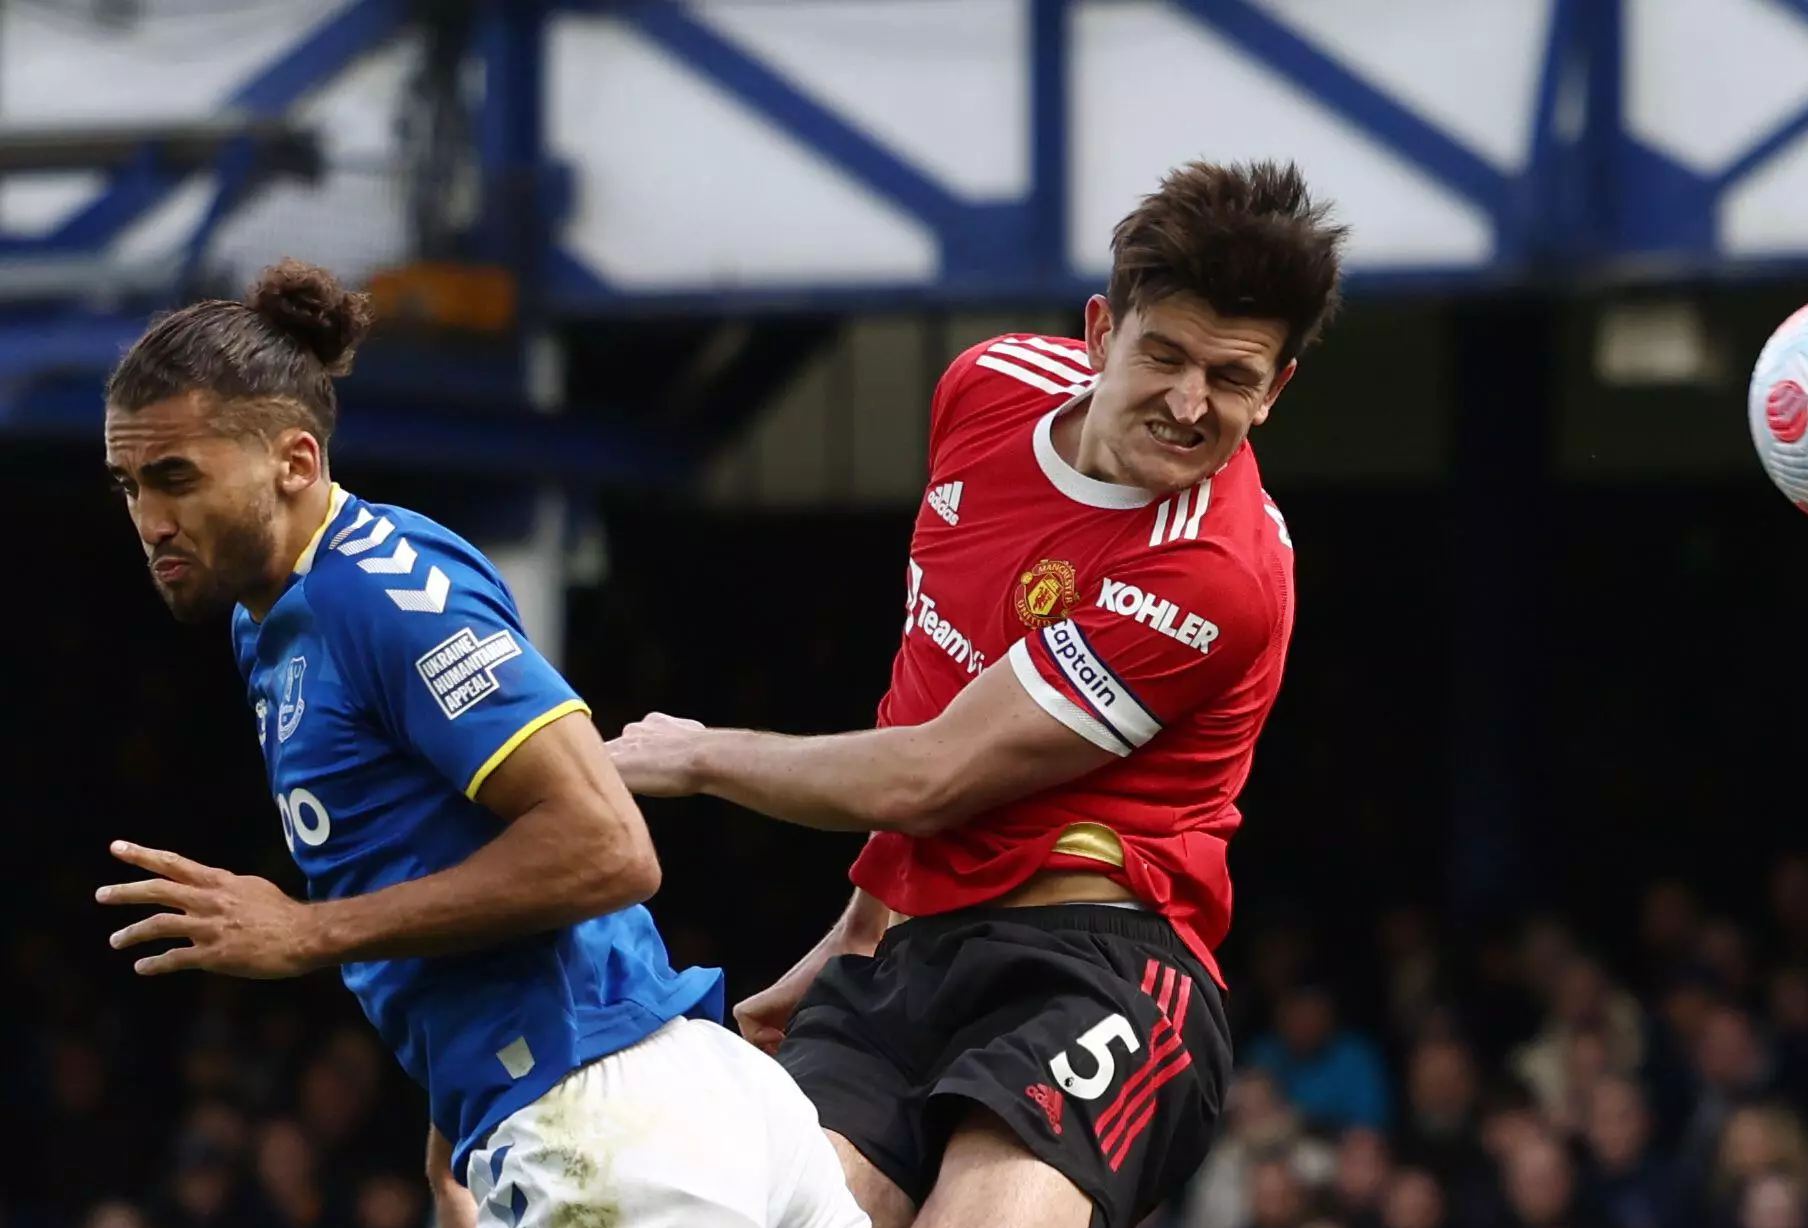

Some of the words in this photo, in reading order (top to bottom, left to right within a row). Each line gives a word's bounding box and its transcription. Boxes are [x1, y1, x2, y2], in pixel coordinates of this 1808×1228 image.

[927, 491, 960, 527] adidas
[1096, 576, 1220, 655] KOHLER
[421, 634, 477, 679] UKRAINE
[444, 673, 492, 712] APPEAL
[1049, 1012, 1142, 1101] 5
